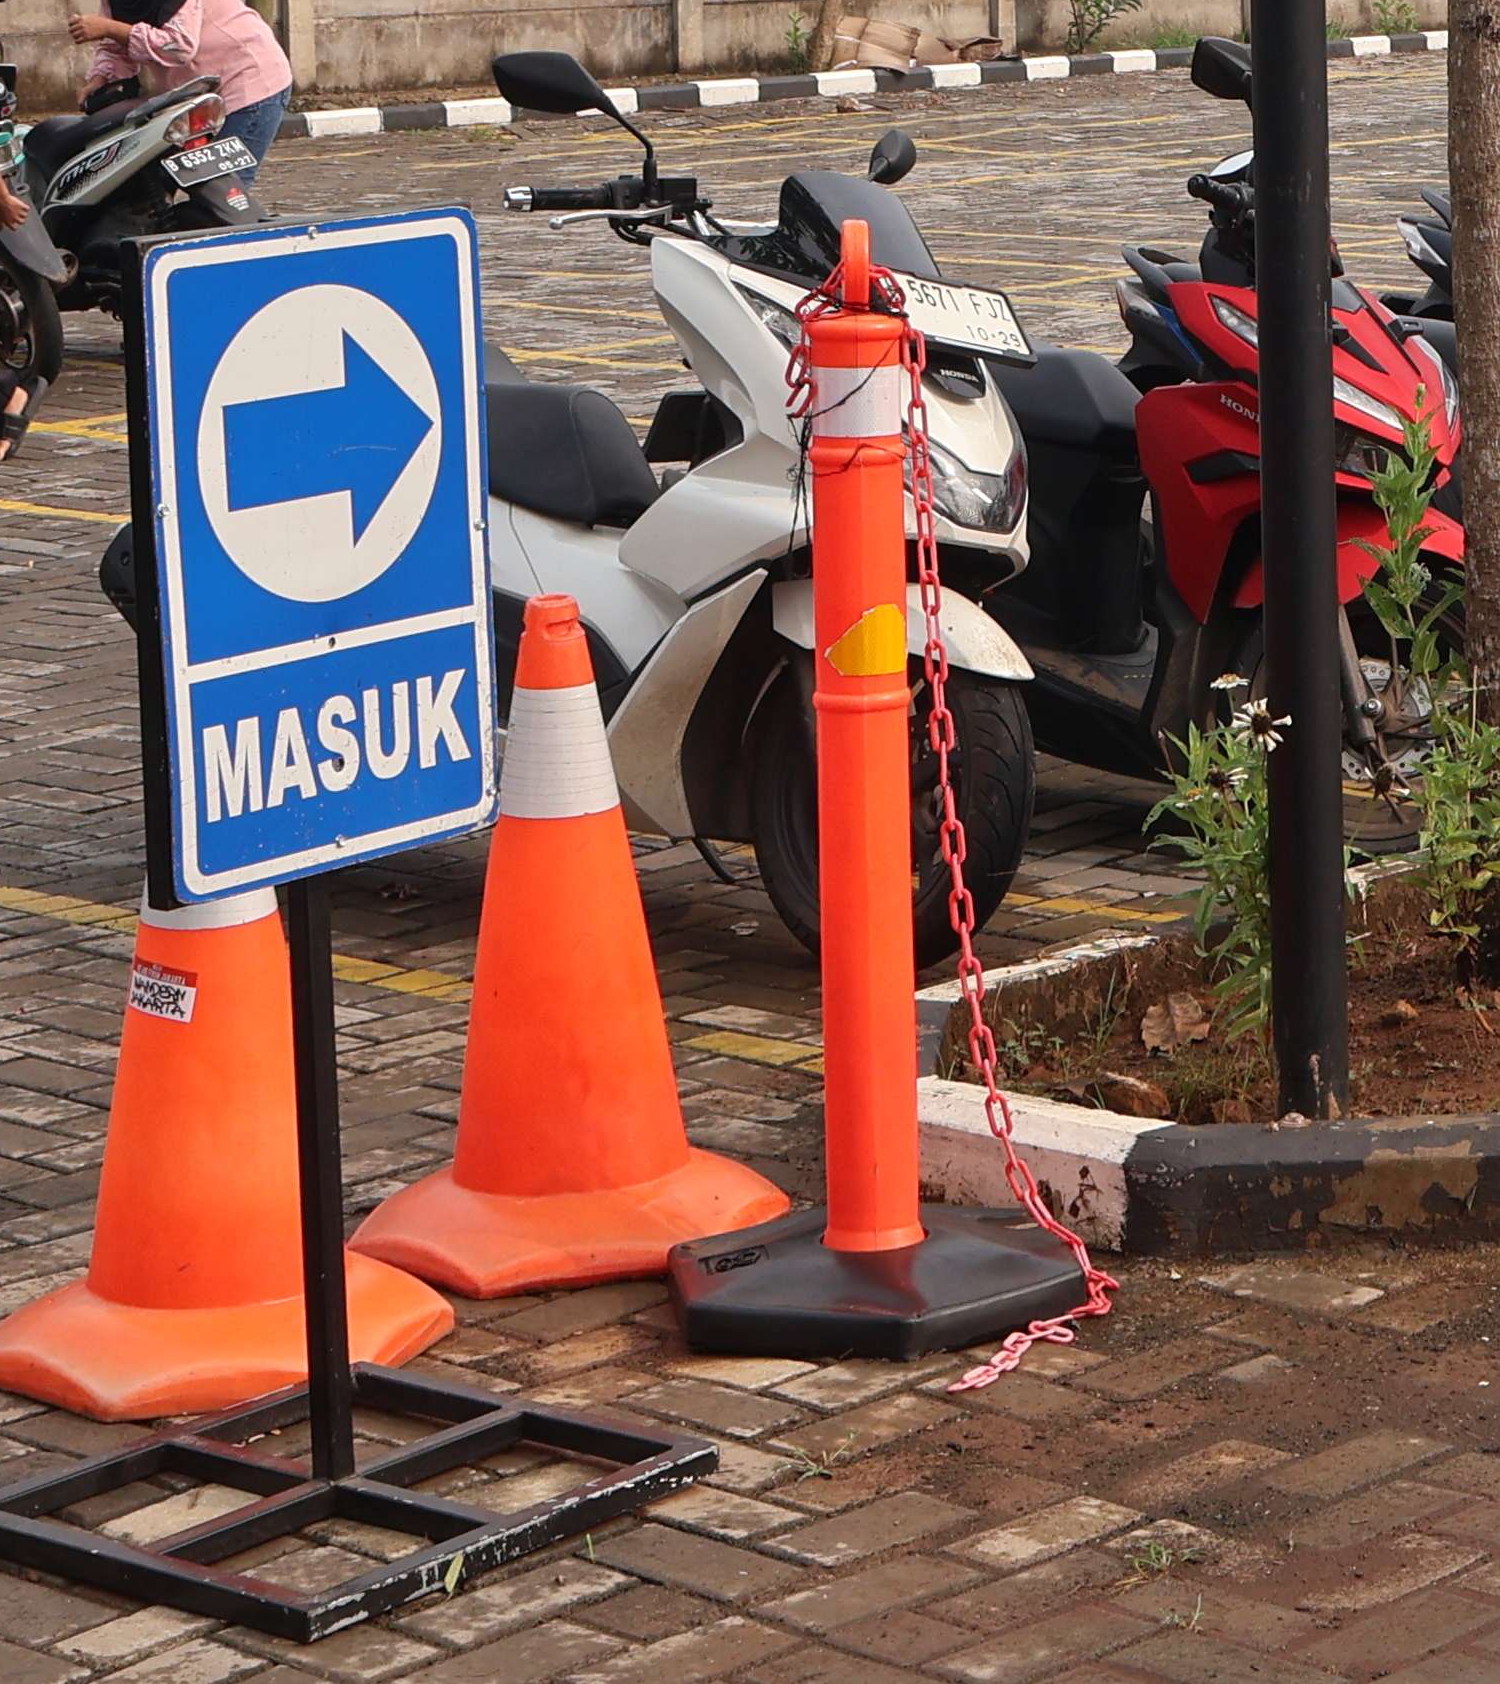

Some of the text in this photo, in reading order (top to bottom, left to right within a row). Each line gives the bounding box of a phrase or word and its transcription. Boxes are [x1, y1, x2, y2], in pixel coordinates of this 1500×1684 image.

[164, 158, 179, 172] B
[180, 148, 216, 168] 6552
[906, 279, 960, 312] 5671
[202, 668, 472, 824] MASUK
